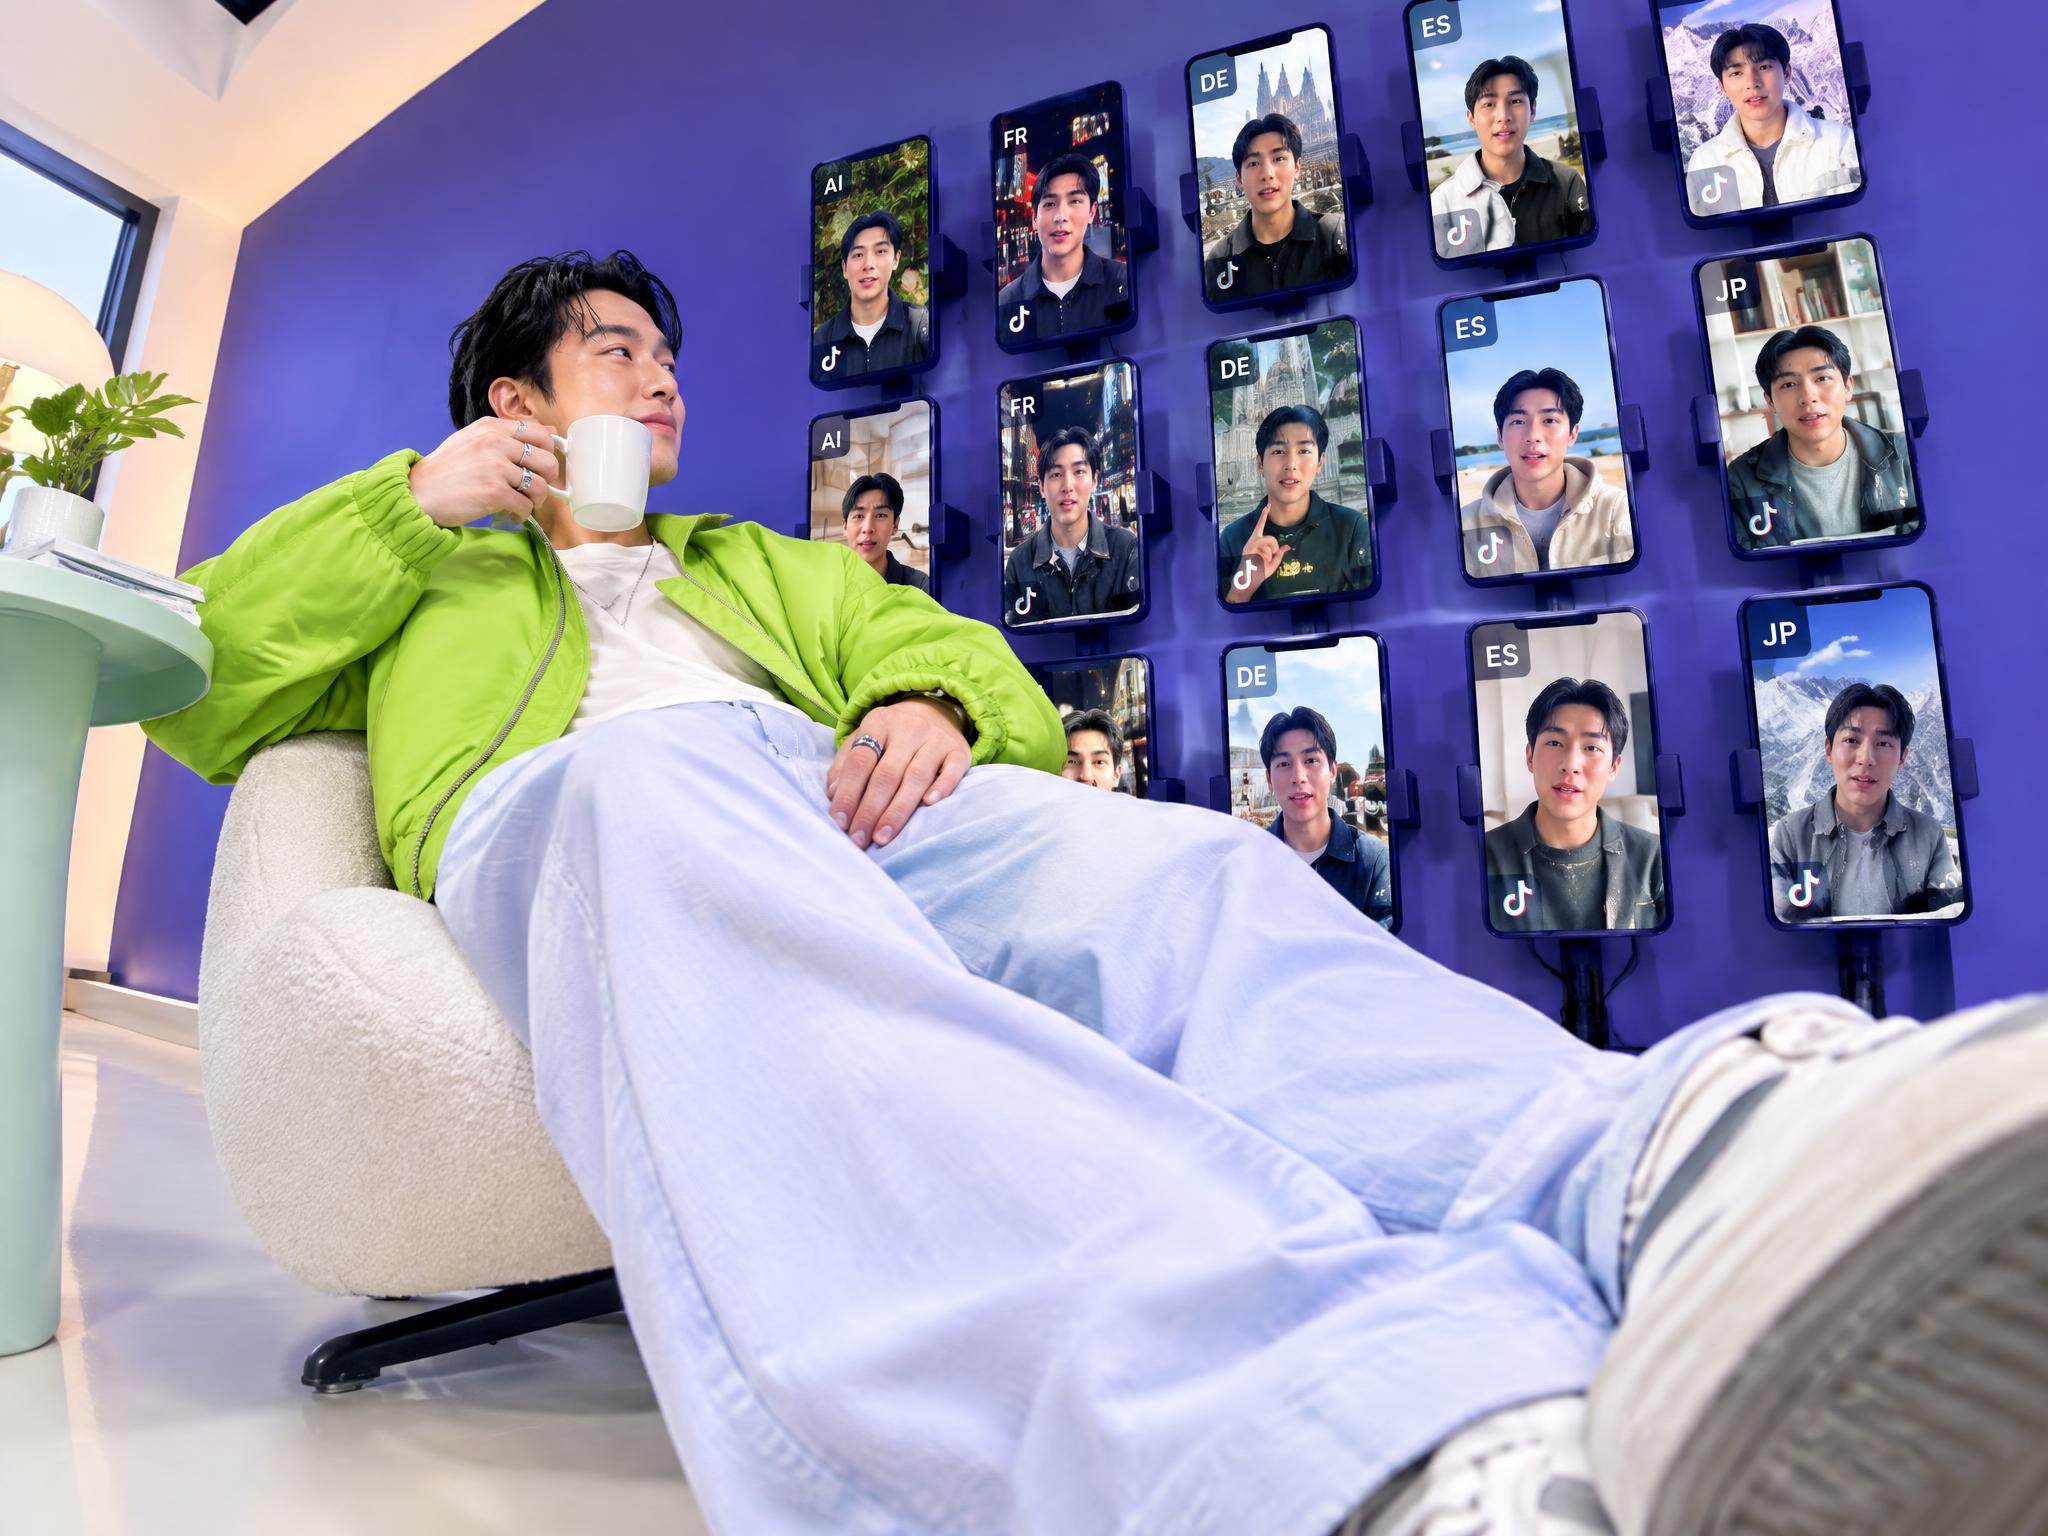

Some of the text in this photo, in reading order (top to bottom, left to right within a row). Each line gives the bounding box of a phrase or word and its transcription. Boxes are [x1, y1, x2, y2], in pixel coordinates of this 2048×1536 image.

[1421, 15, 1451, 38] ES
[1200, 69, 1228, 92] DE
[1004, 127, 1028, 148] FR
[824, 175, 842, 195] AI
[1716, 278, 1747, 303] JP
[1455, 316, 1486, 339] ES
[1220, 356, 1250, 379] DE
[1010, 396, 1035, 416] FR
[821, 430, 840, 450] AI
[1762, 621, 1796, 646] JP
[1486, 644, 1518, 667] ES
[1237, 665, 1267, 688] DE
